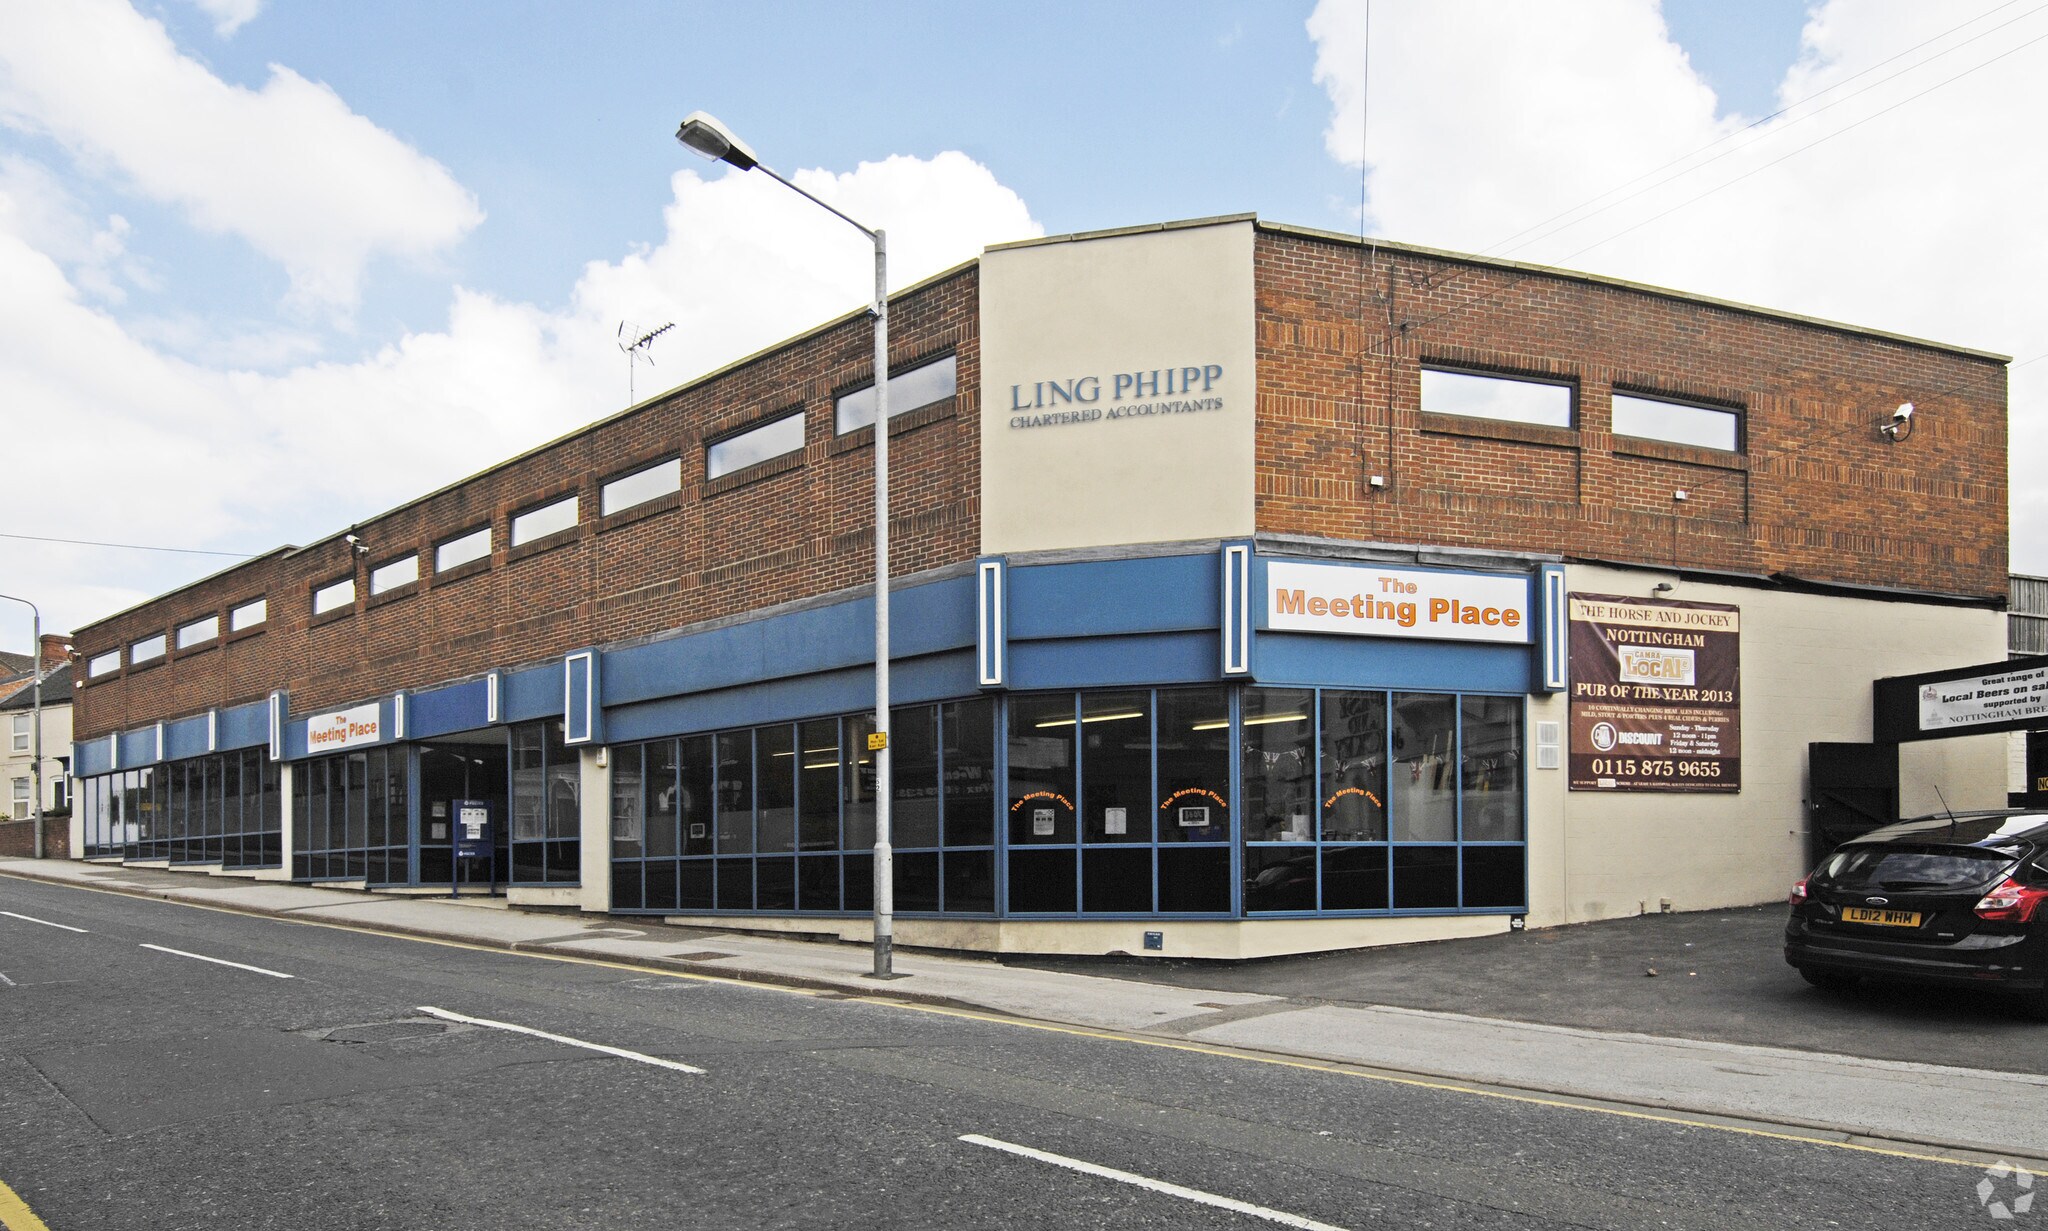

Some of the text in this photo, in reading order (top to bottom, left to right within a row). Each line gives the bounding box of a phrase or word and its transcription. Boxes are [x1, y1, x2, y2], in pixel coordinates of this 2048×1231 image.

[1010, 364, 1223, 410] LING PHIPP
[1010, 397, 1223, 428] CHARTERED ACCOUNTANTS
[1378, 576, 1418, 594] The
[1276, 588, 1520, 627] Meeting Place
[1580, 604, 1731, 626] THE HORSE AND JOCKEY
[1606, 628, 1704, 647] NOTTINGHAM
[2007, 673, 2033, 682] range
[1576, 682, 1732, 702] PUB OF THE YEAR 2013
[1942, 692, 1973, 703] Local
[1976, 688, 2010, 699] Beers
[2013, 685, 2028, 694] on
[1983, 697, 2027, 708] supported
[336, 715, 346, 724] The
[1949, 708, 2022, 724] NOTTINGHAM
[310, 722, 376, 744] Meeting Place
[1618, 732, 1662, 746] DISCOUNT
[1592, 759, 1720, 777] 0115 875 9655
[1011, 790, 1074, 811] The Meeting Place
[1160, 787, 1227, 809] The Meeting Place
[1325, 787, 1382, 808] The Meeting Place
[1850, 909, 1913, 924] LD12 WHM
